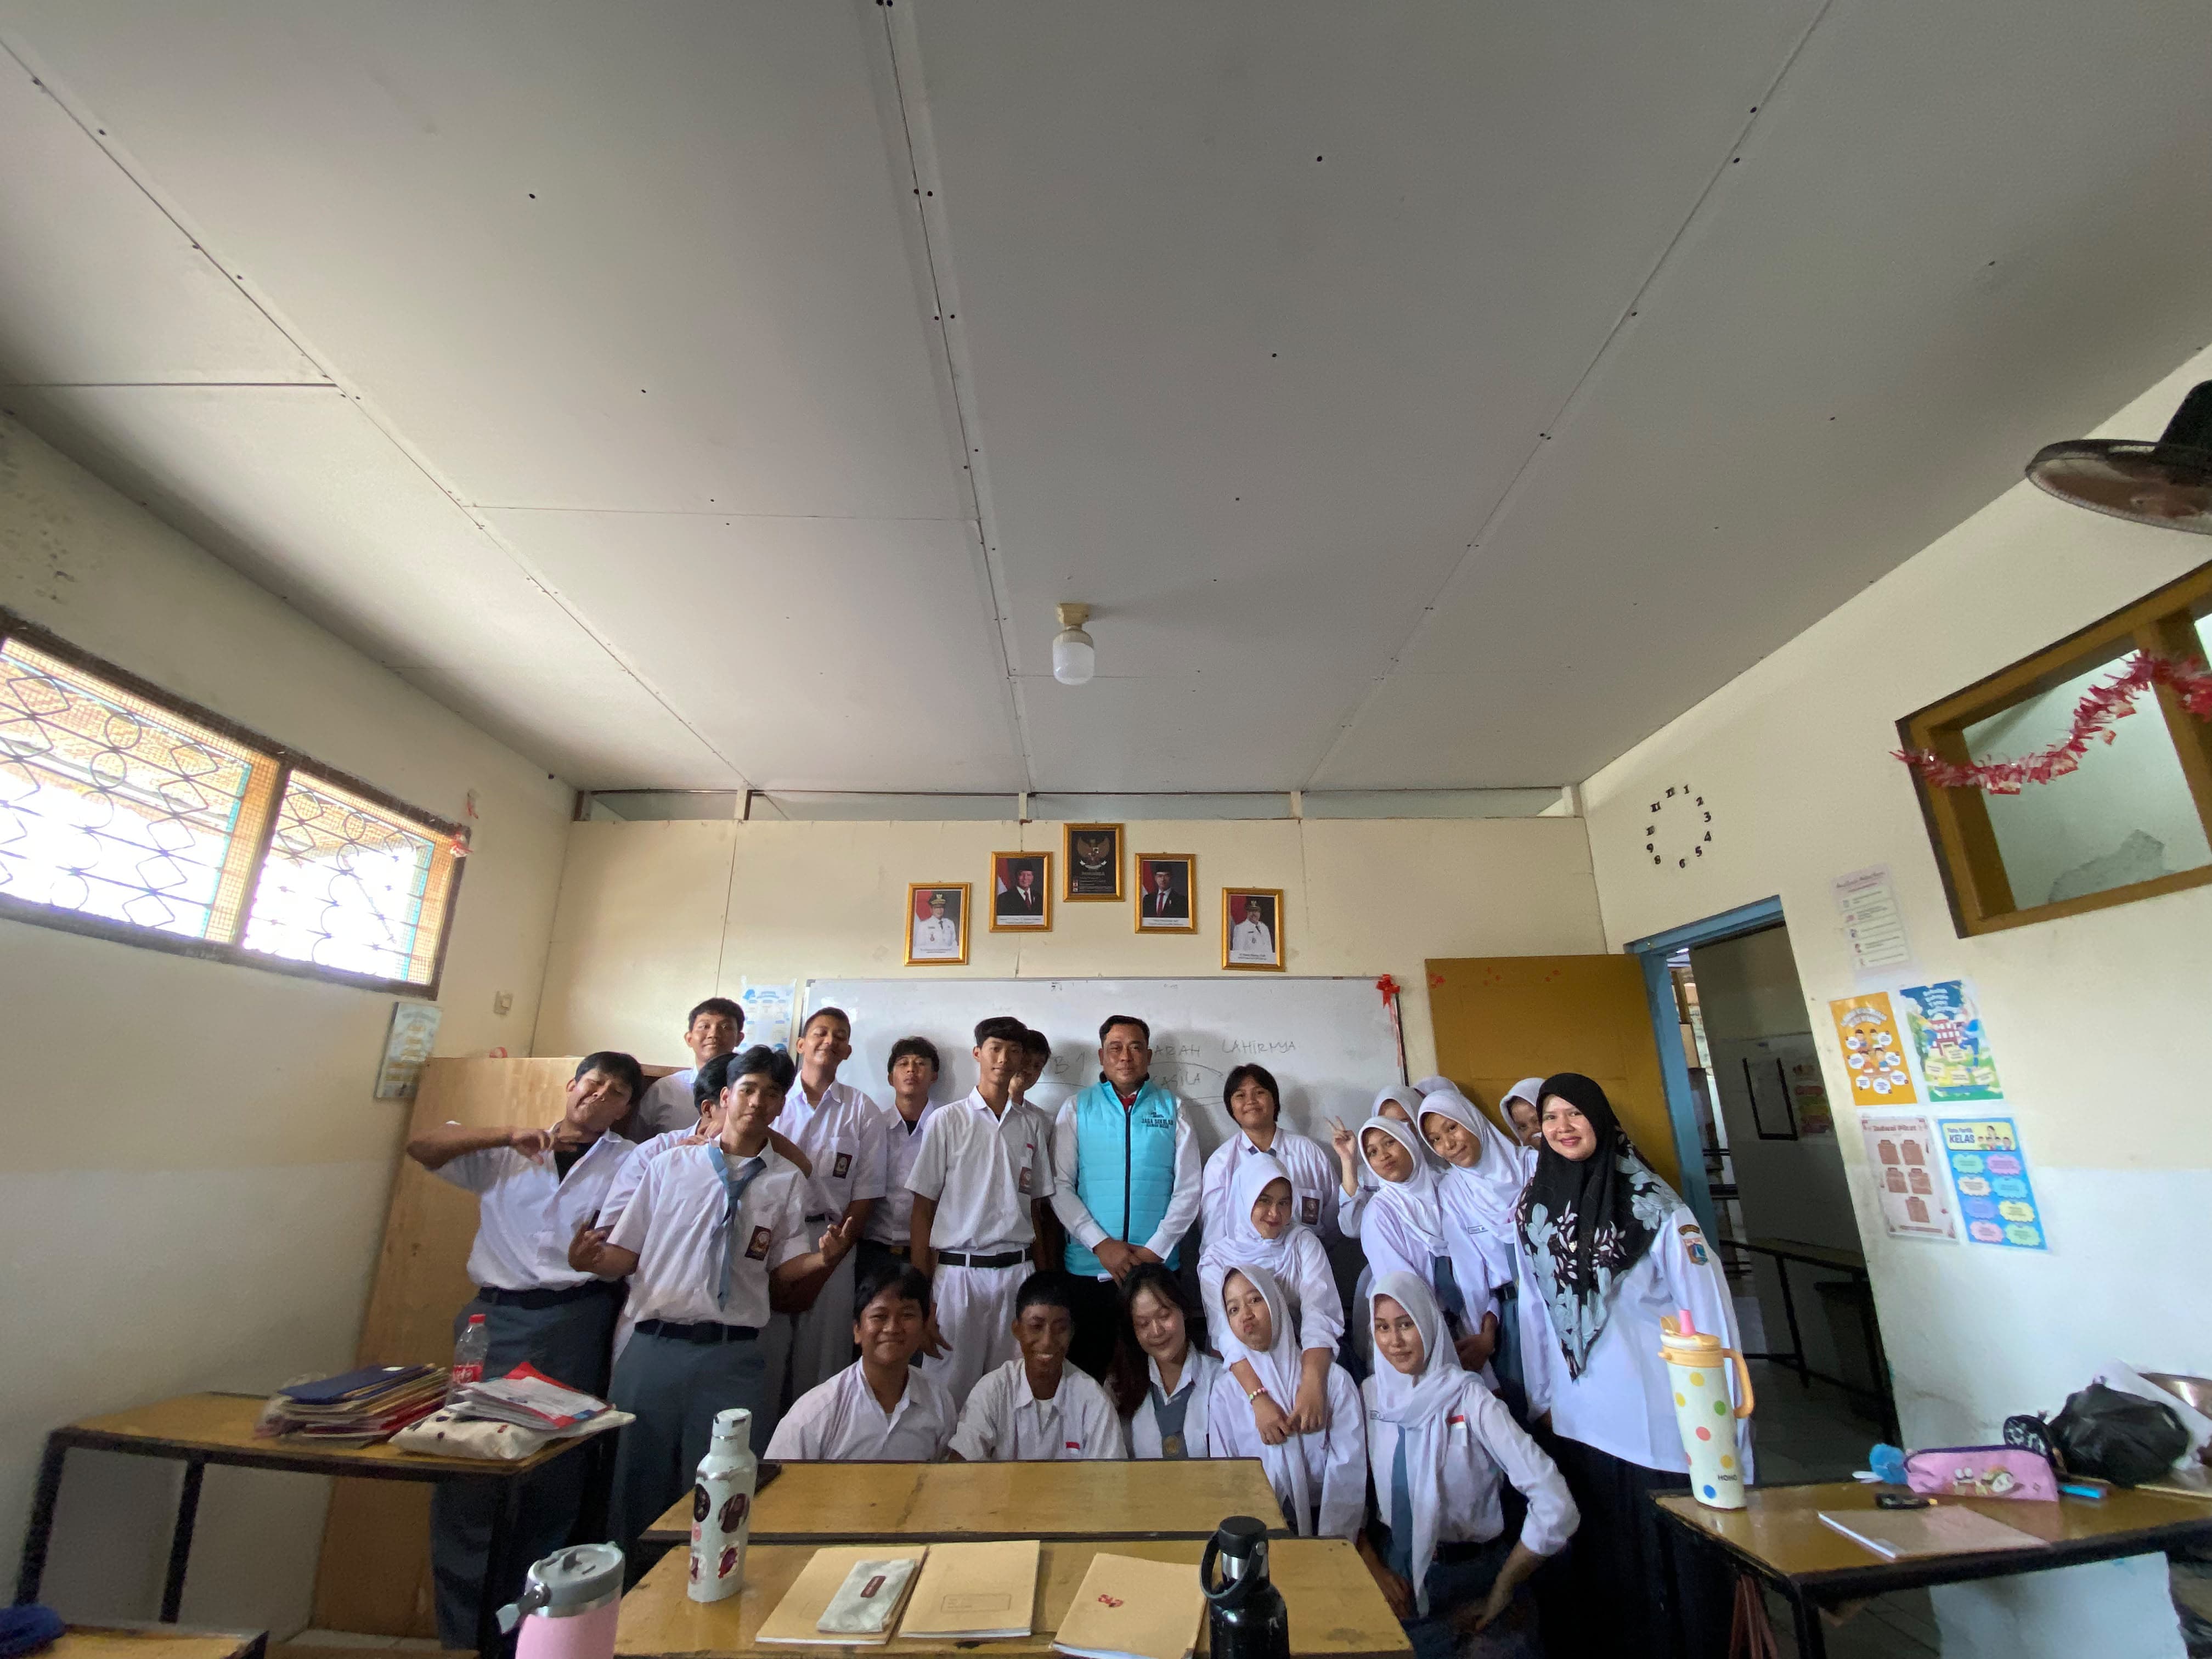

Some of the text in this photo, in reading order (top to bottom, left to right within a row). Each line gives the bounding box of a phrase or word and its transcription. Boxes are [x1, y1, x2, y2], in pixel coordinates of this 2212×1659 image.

[1684, 784, 1690, 794] 1
[1696, 797, 1704, 806] 2
[1703, 811, 1712, 822] 3
[1704, 831, 1712, 842] 4
[1646, 843, 1654, 853] 9
[1695, 846, 1702, 857] 5
[1654, 855, 1661, 865] 8
[1679, 859, 1685, 868] 6
[1949, 1135, 1975, 1144] KELAS
